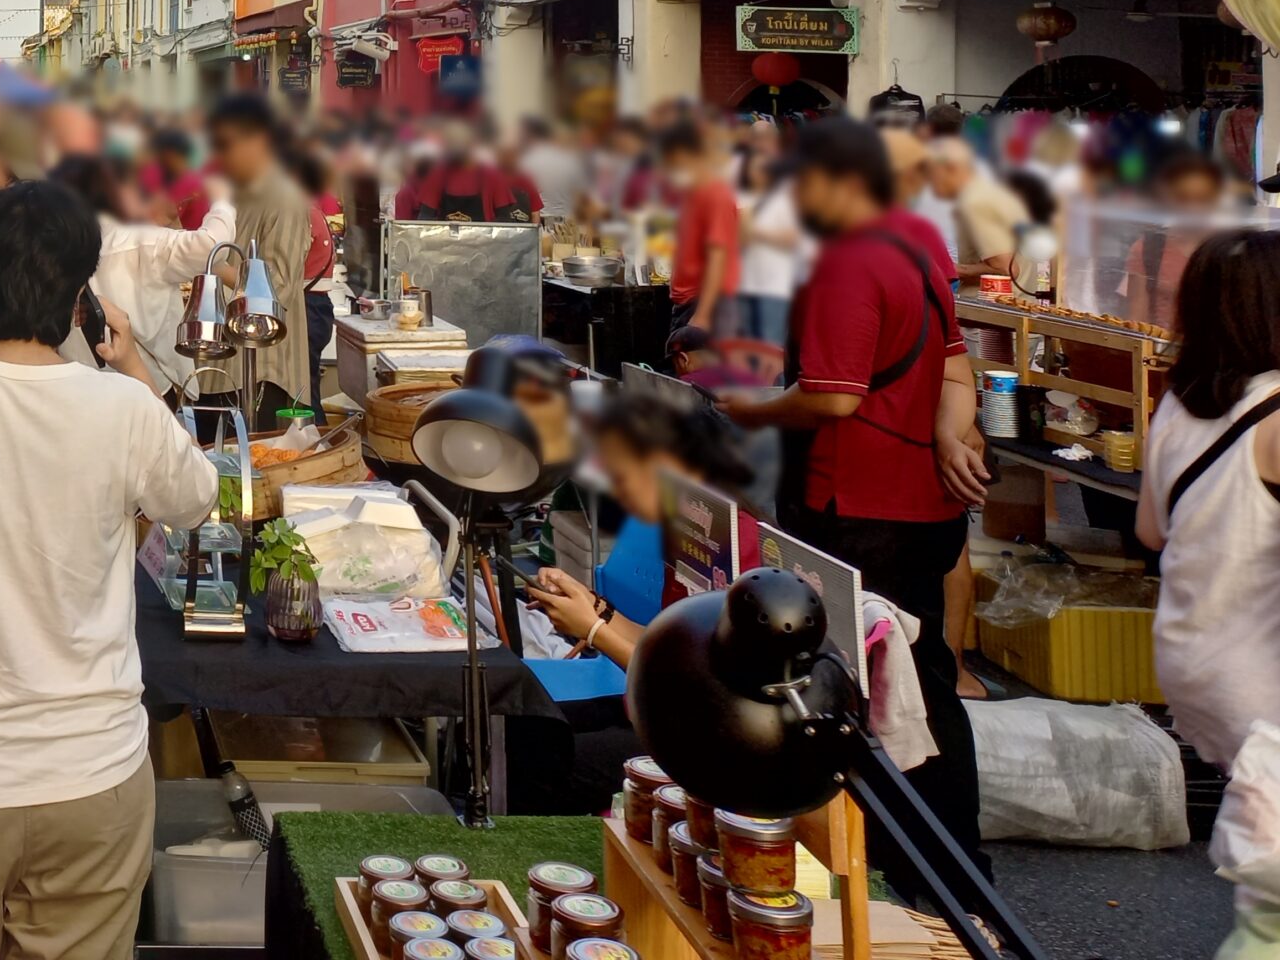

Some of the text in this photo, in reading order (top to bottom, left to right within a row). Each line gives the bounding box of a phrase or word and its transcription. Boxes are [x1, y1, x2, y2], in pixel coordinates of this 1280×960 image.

[761, 36, 834, 47] KOPITIAM BY WILAI
